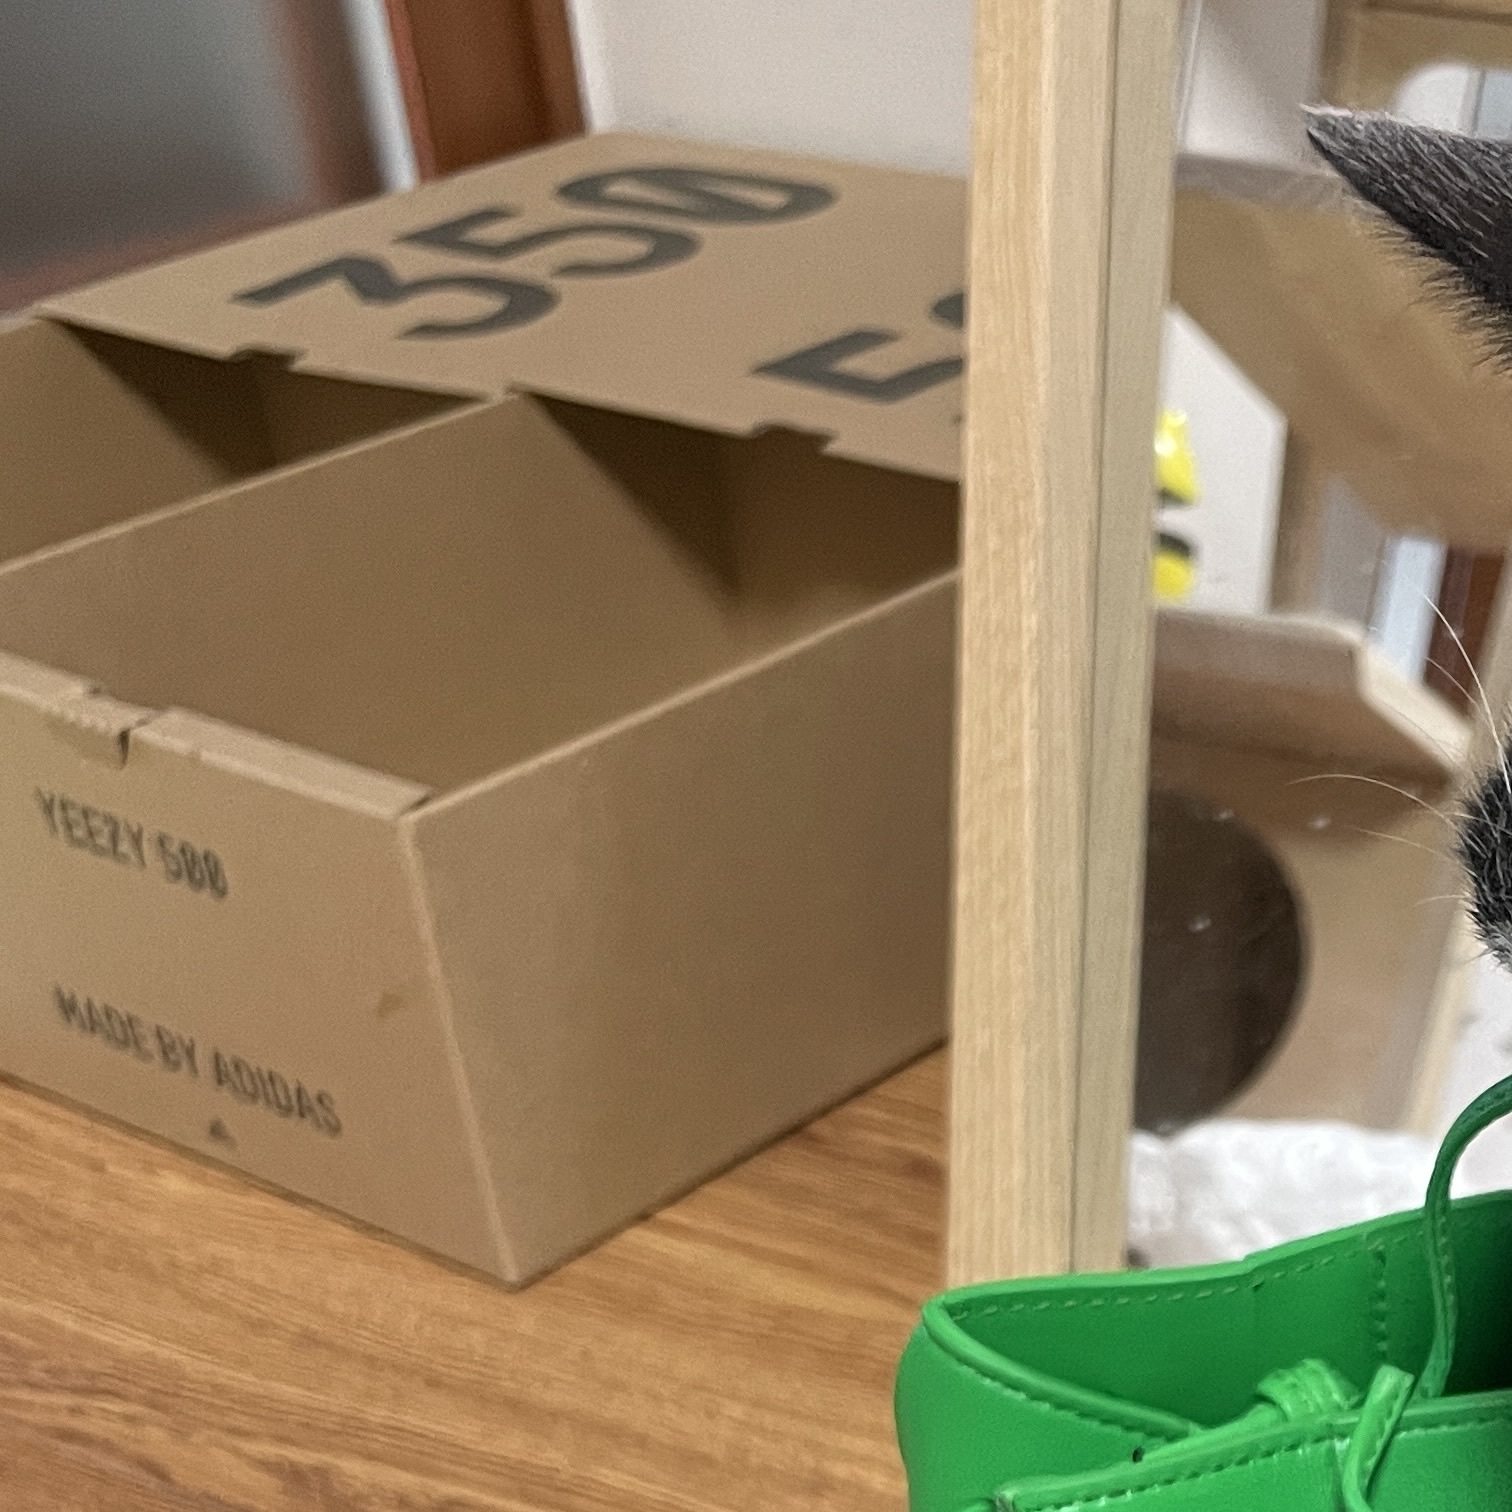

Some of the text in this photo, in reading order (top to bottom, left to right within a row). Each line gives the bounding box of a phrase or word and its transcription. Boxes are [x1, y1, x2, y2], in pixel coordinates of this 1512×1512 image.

[227, 166, 841, 341] 350
[34, 786, 229, 899] YEEZY 500
[54, 984, 343, 1138] MADE BY ADIDAS
